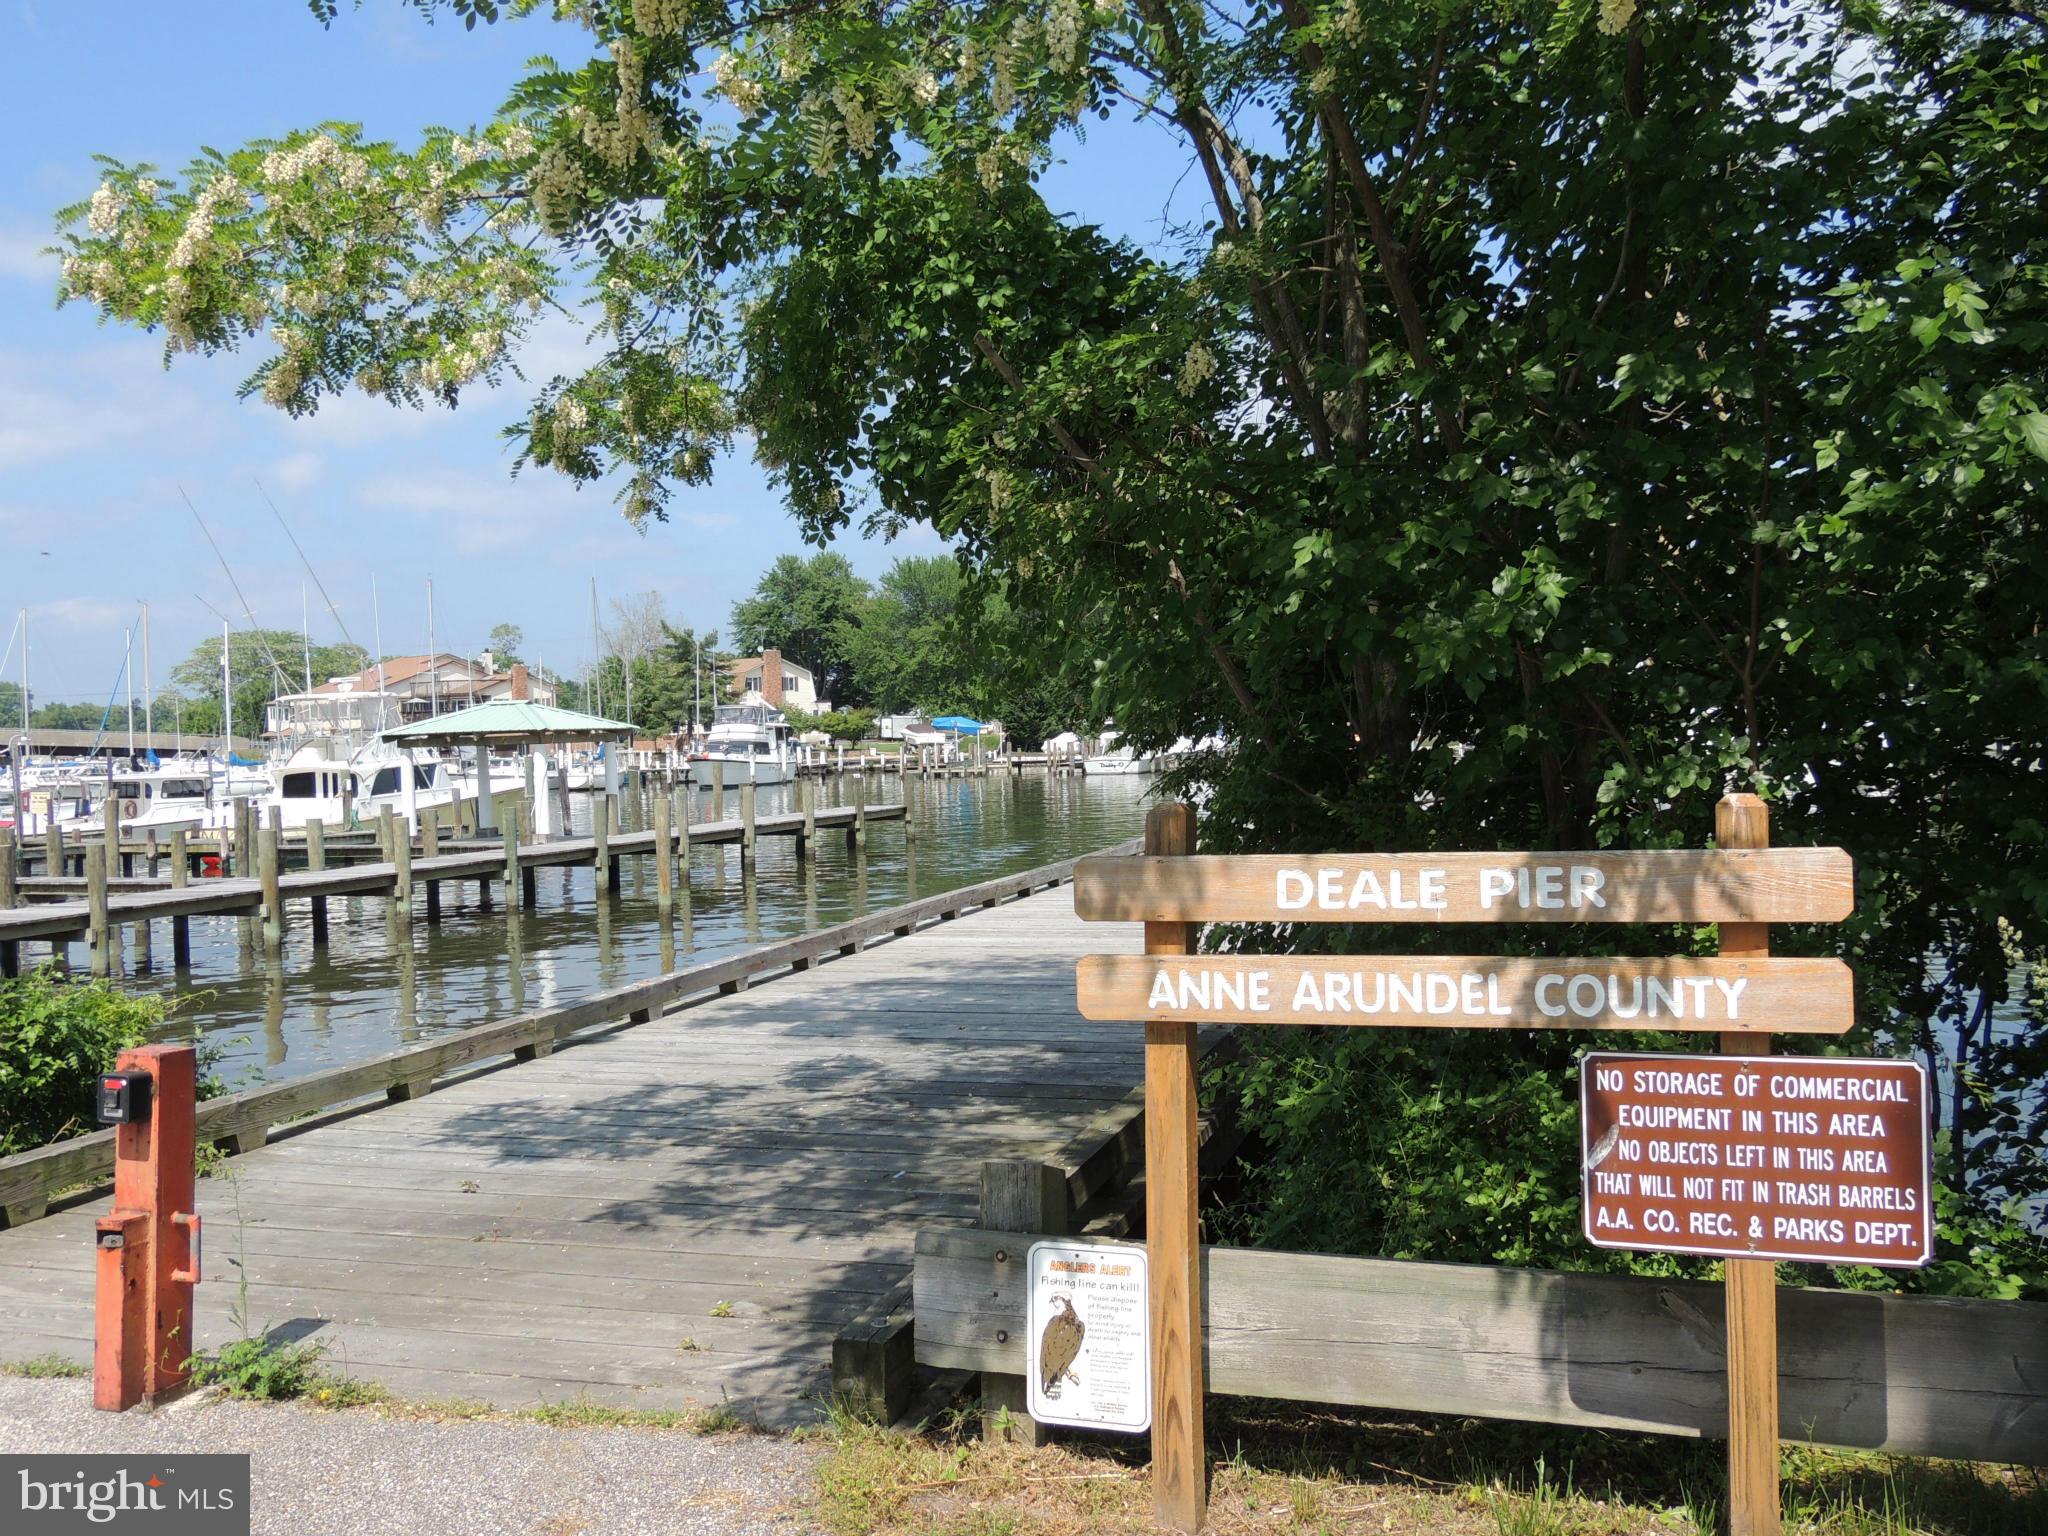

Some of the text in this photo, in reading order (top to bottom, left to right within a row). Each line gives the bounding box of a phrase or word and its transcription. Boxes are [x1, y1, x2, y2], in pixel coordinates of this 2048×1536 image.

[1276, 866, 1606, 910] DEALE PIER
[1148, 968, 1748, 1019] ANNE ARUNDEL COUNTY
[1597, 1070, 1908, 1102] NO STORAGE OF COMMERCIAL
[1619, 1105, 1885, 1137] EQUIPMENT IN THIS AREA
[1619, 1140, 1887, 1173] NO OBJECTS LEFT IN THIS AREA
[1595, 1172, 1915, 1211] THAT WILL NOT FIT IN TRASH BARRELS
[1596, 1207, 1916, 1246] A.A. CO. REC. & PARKS DEPT.
[1042, 1276, 1075, 1289] Fishing
[1079, 1279, 1096, 1288] line
[1050, 1260, 1131, 1276] ANGLERS ALERT
